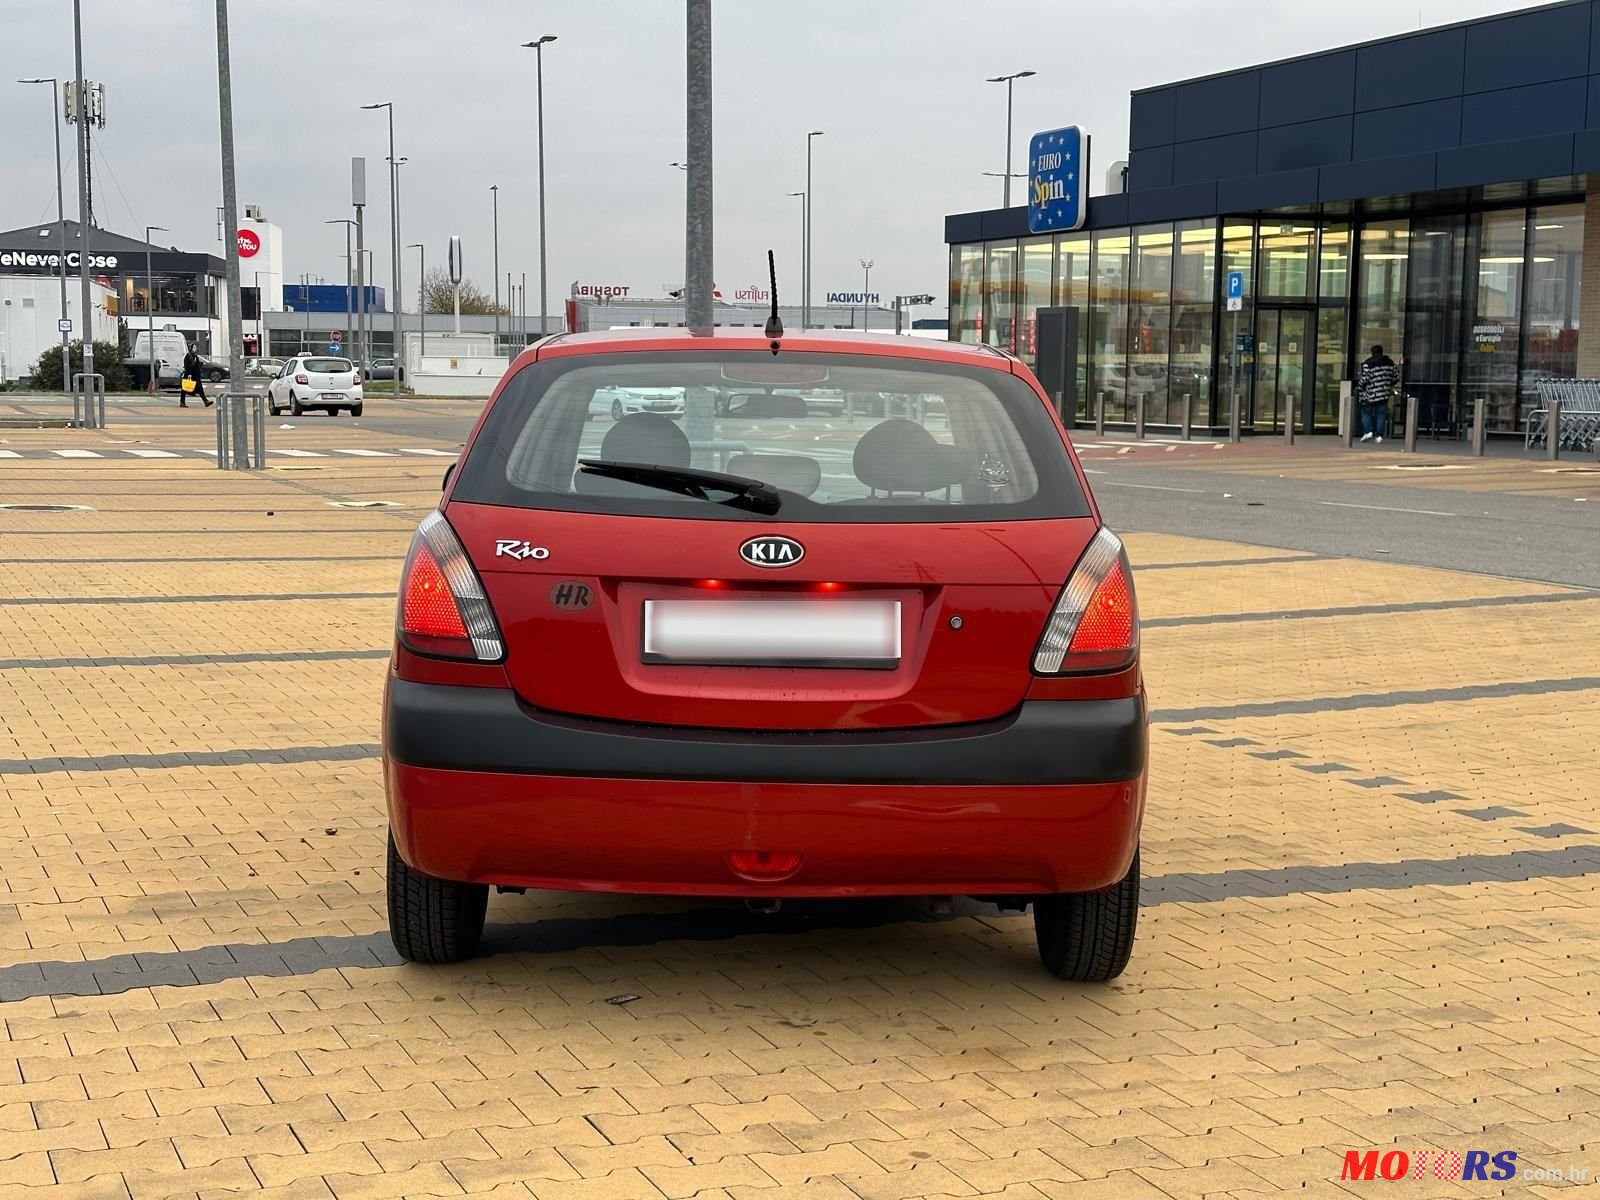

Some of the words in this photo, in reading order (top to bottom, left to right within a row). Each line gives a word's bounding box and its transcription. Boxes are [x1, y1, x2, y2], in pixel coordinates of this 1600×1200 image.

[1038, 152, 1062, 172] EURO
[1034, 174, 1065, 210] Spin
[0, 251, 118, 268] eNeverCose
[1231, 277, 1239, 293] P
[495, 539, 550, 560] Rio
[751, 543, 794, 560] KIA
[555, 584, 589, 606] HR
